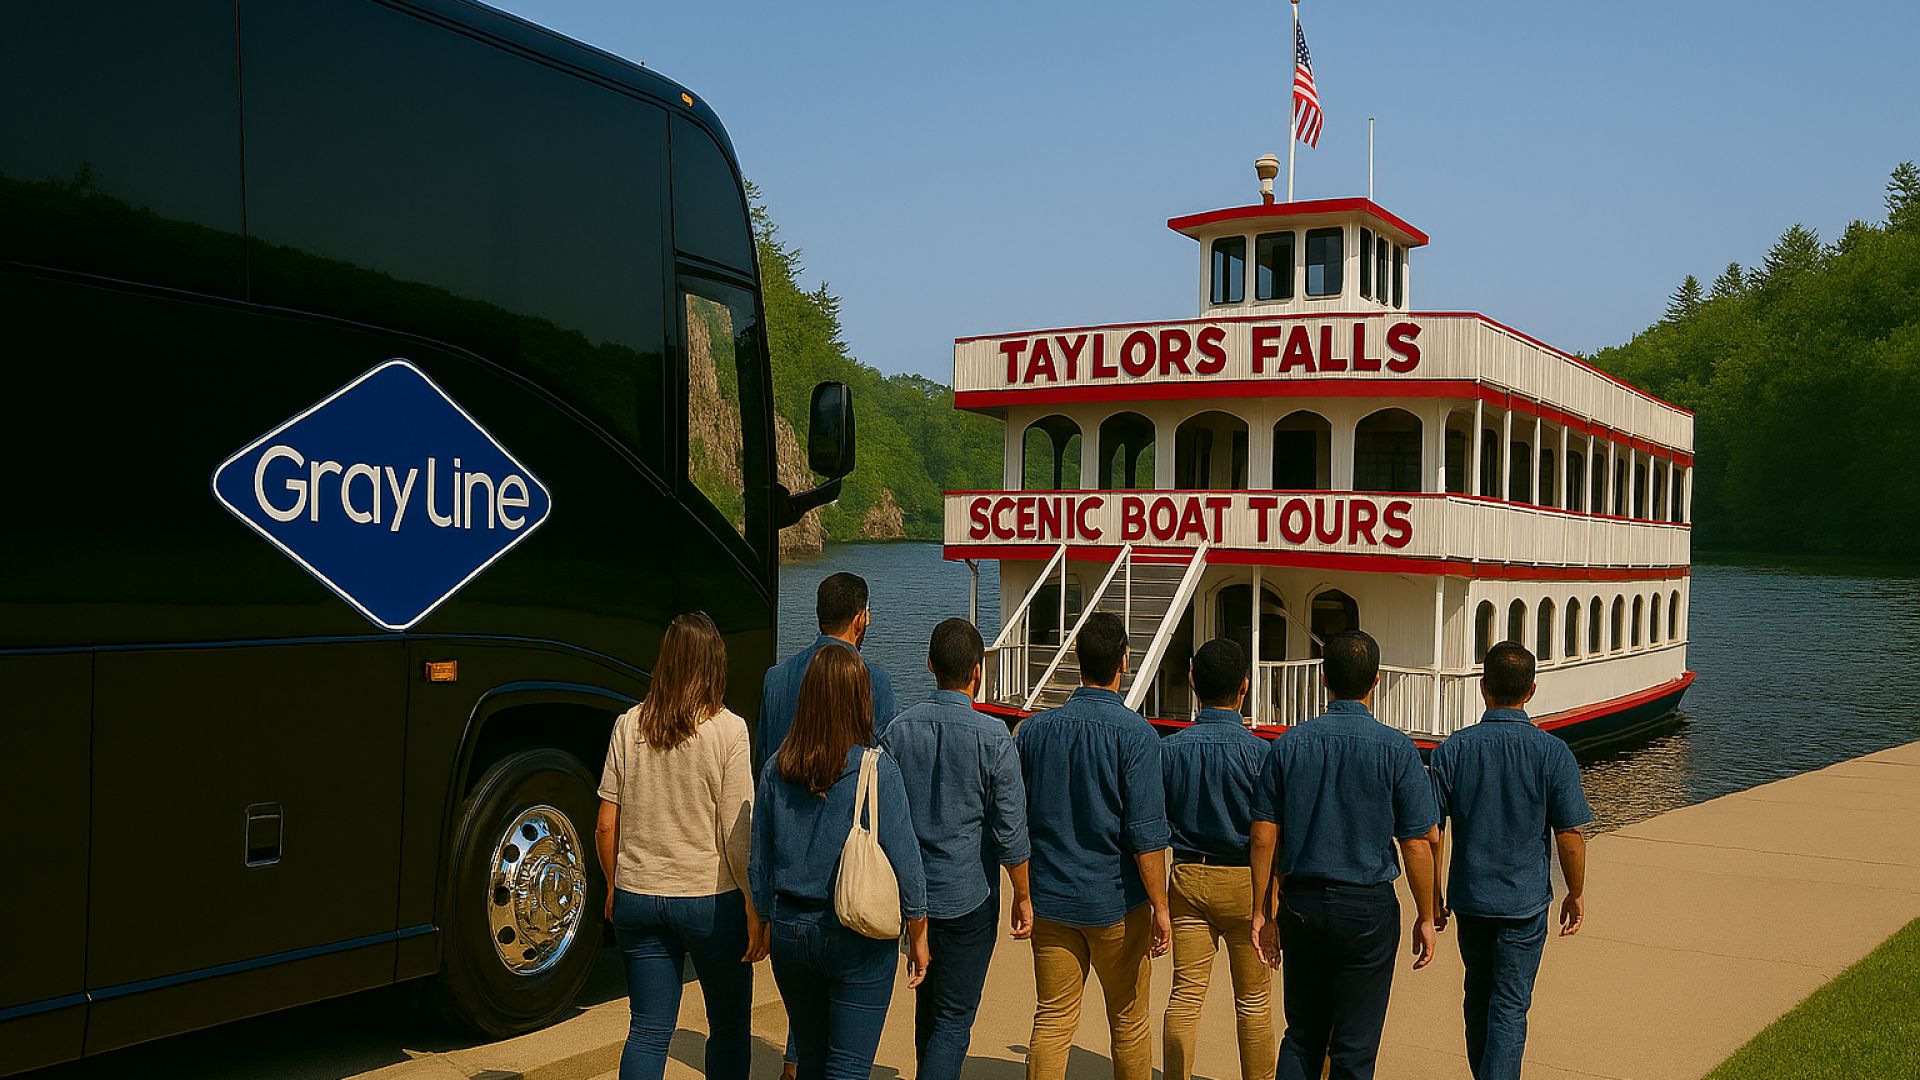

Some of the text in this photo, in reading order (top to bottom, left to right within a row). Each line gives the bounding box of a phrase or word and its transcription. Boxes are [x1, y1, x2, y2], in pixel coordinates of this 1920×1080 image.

[998, 322, 1421, 384] TAYLORS FALLS
[254, 445, 418, 532] Gray
[969, 495, 1413, 548] SCENIC BOAT TOURS
